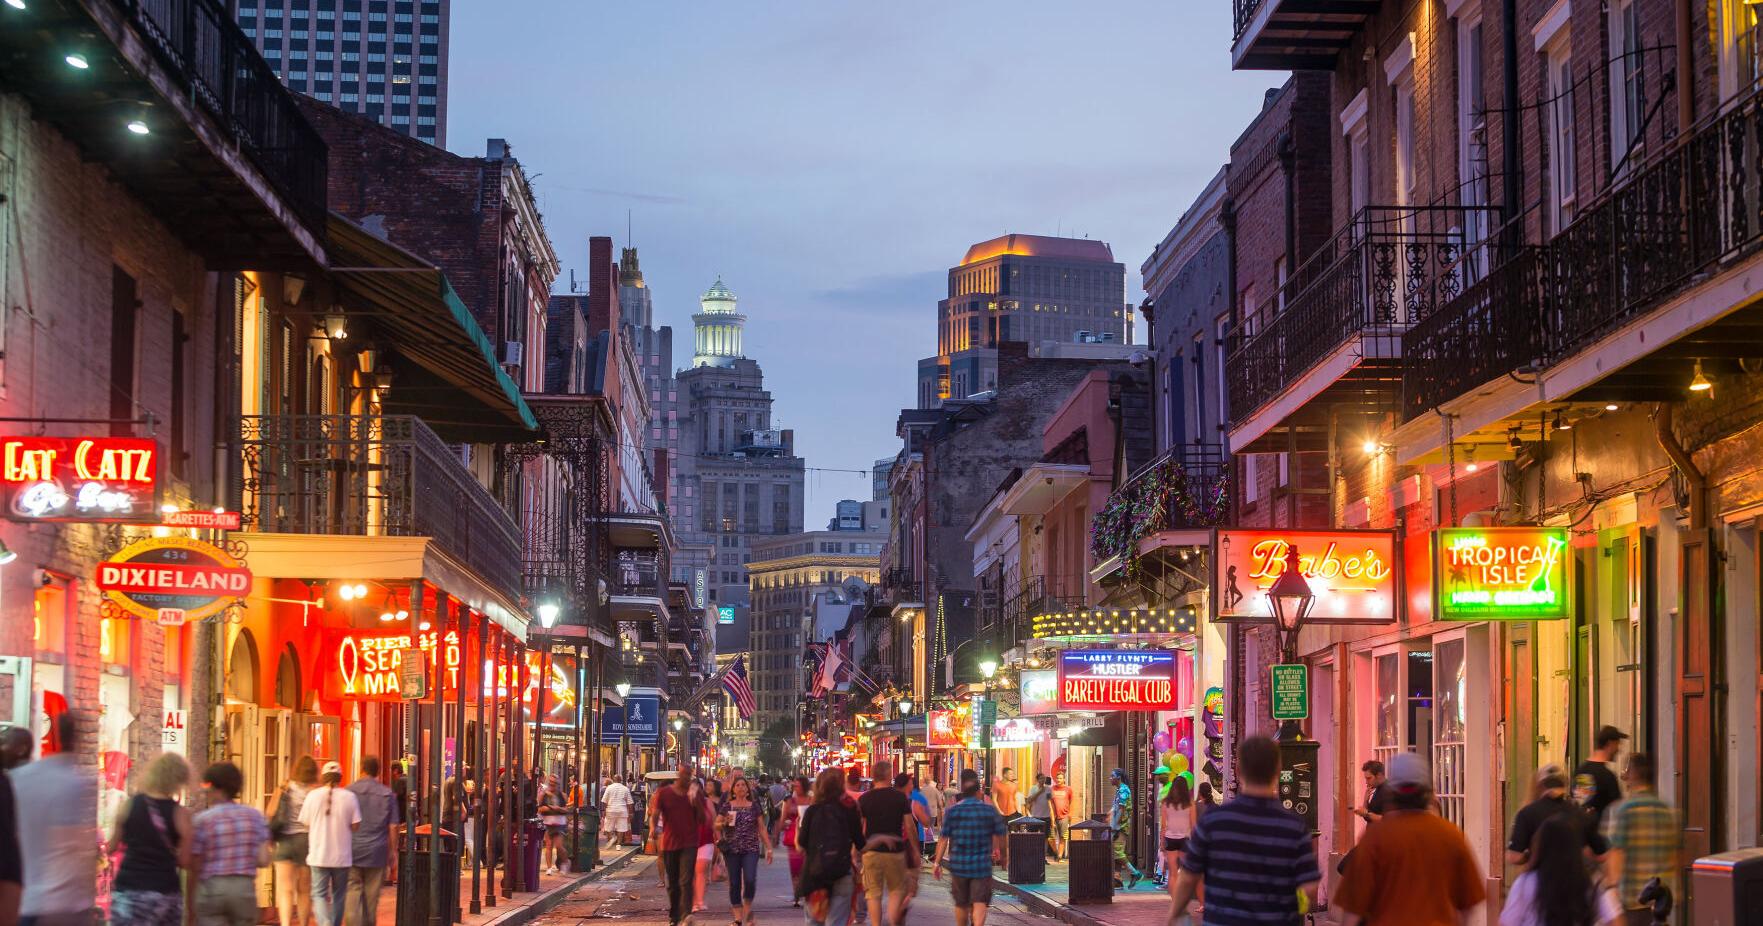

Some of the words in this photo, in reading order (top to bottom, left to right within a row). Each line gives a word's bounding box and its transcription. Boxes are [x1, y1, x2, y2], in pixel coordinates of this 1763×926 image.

[74, 439, 152, 482] CATZ
[162, 550, 188, 560] 434
[102, 567, 248, 591] DIXIELAND
[1482, 565, 1528, 584] ISLE
[696, 570, 704, 609] ASTO
[160, 611, 183, 622] ATM
[360, 635, 411, 651] PIER
[1083, 654, 1112, 662] LARRY
[1117, 655, 1154, 663] FLYNT'S
[1092, 663, 1140, 675] HUSTLER
[1065, 680, 1106, 703] BARELY
[1109, 680, 1142, 703] LEGAL
[1145, 680, 1172, 703] CLUB
[1034, 719, 1060, 728] FRESH
[1081, 717, 1104, 727] GRILL
